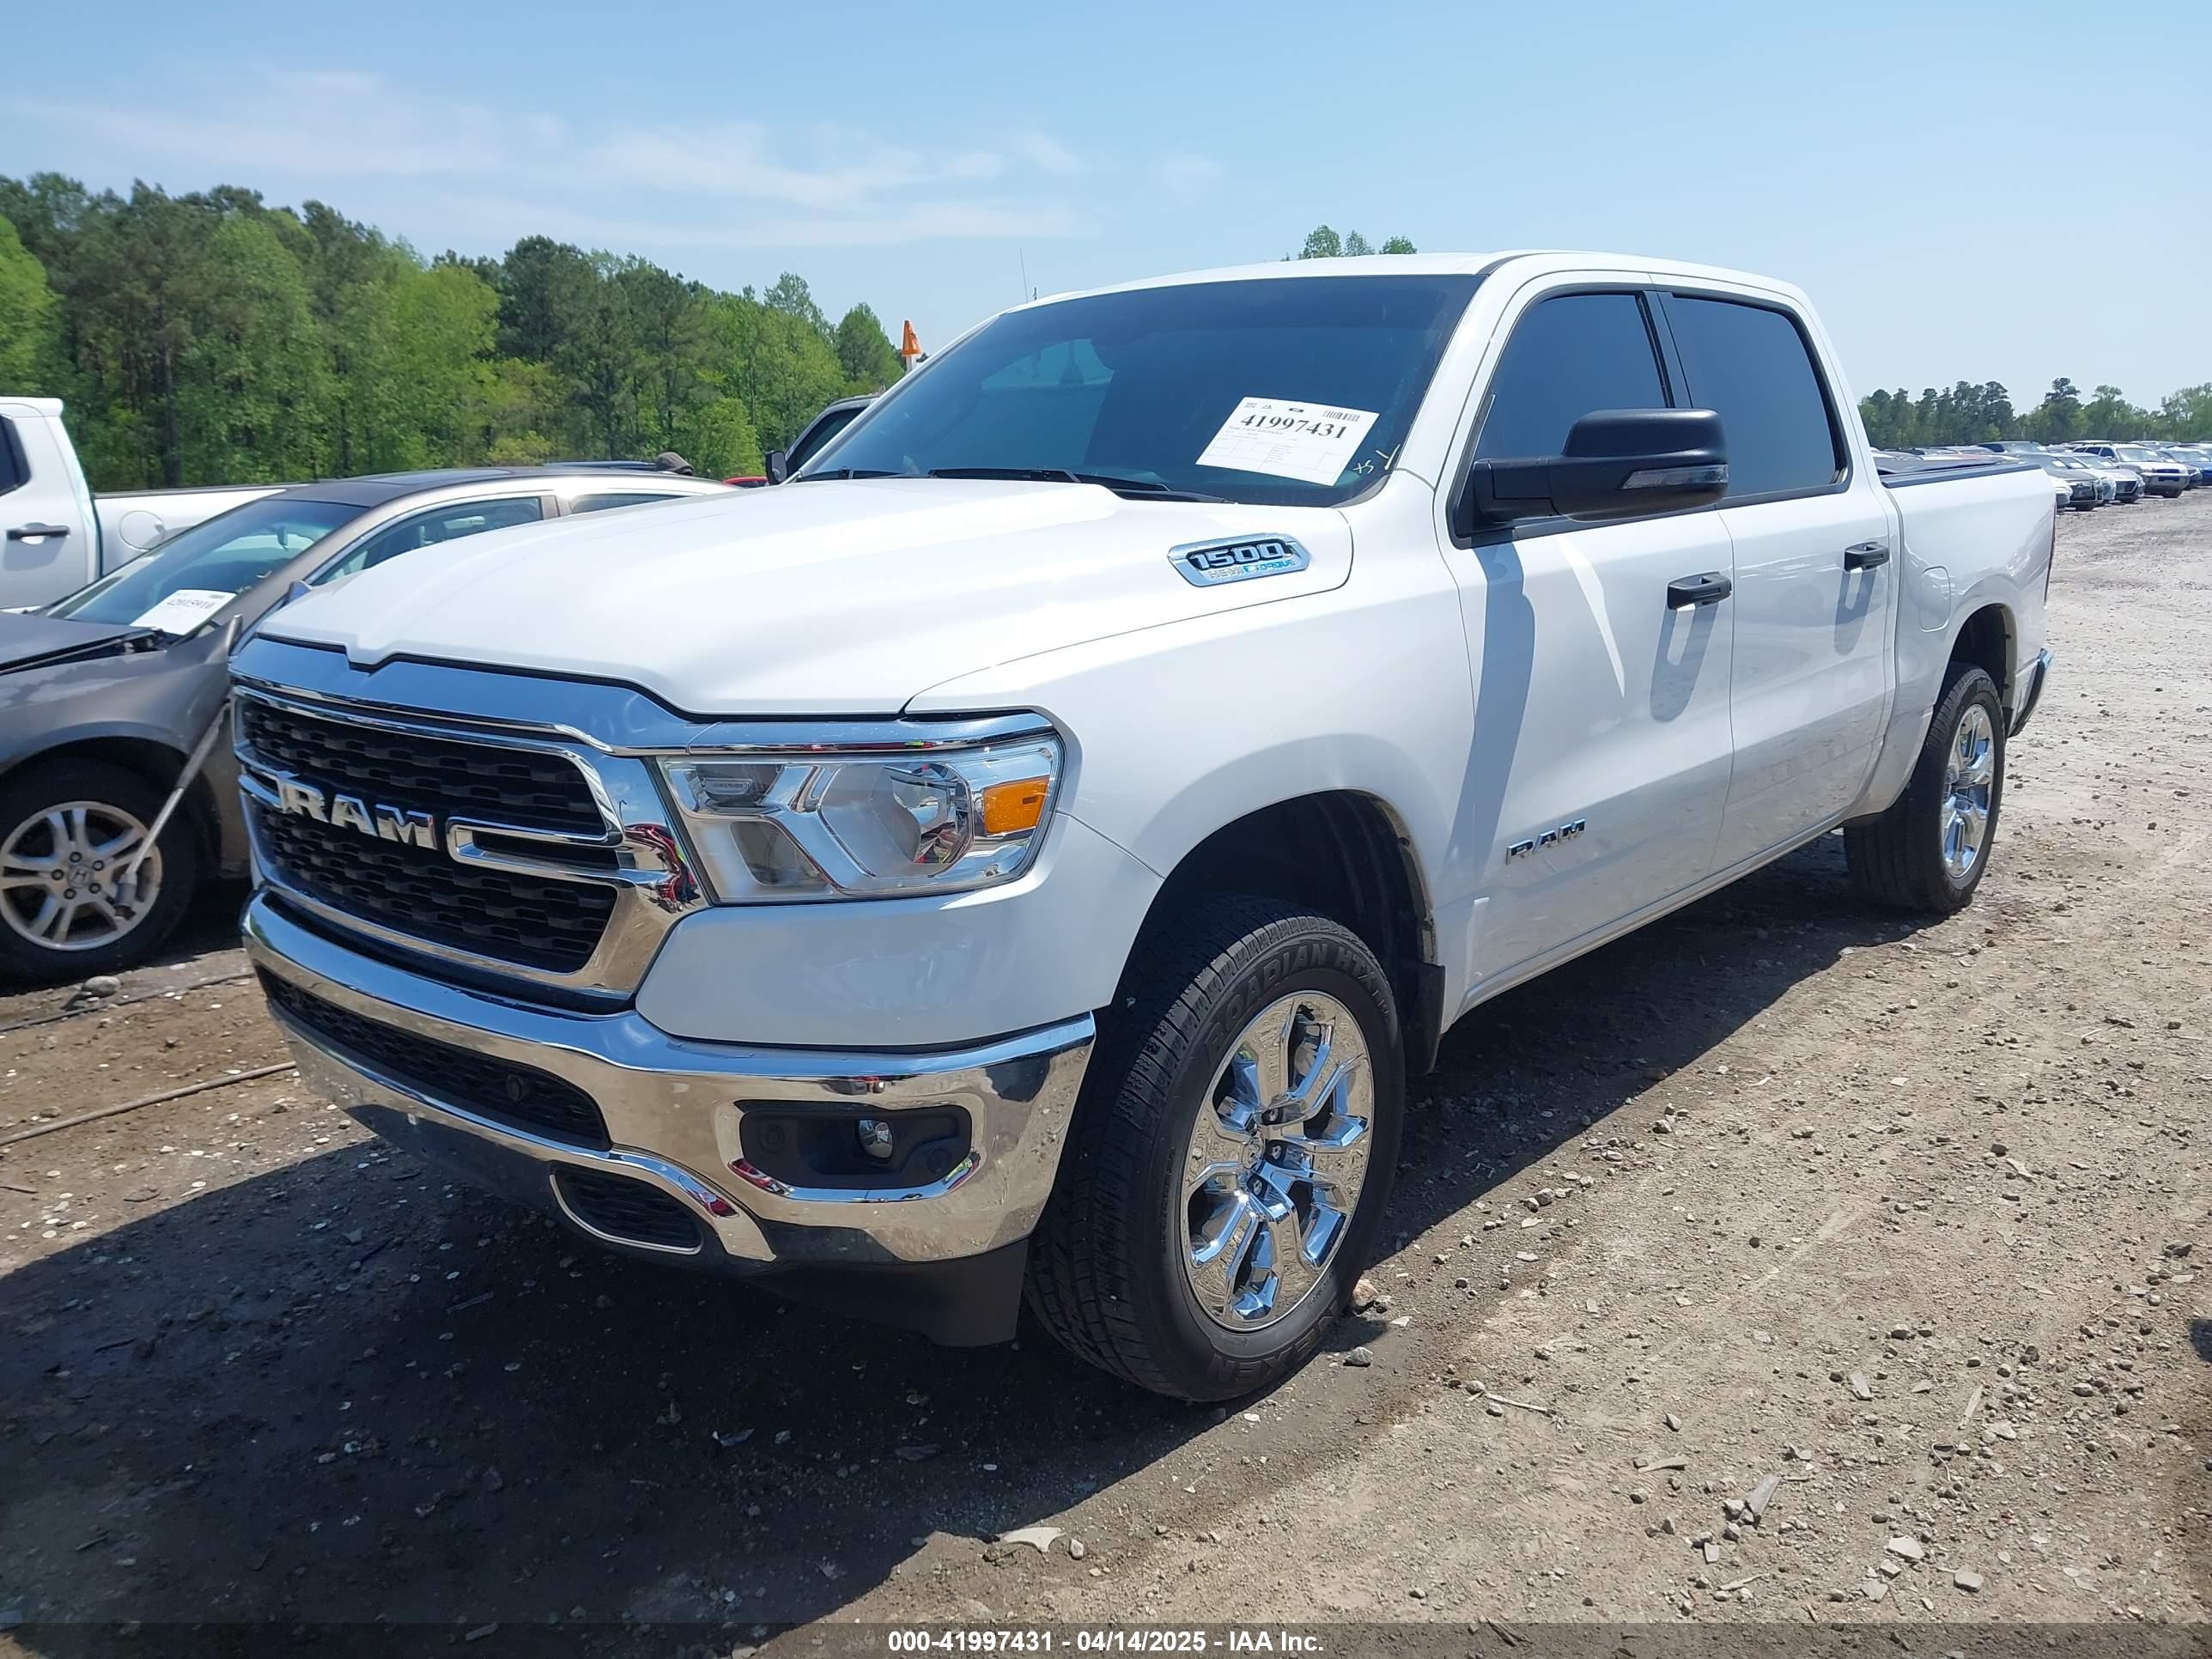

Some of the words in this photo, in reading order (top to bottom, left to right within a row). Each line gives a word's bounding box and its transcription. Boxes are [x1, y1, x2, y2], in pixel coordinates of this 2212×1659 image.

[1241, 414, 1347, 439] 41997431
[1191, 543, 1285, 568] 1500
[282, 776, 438, 851] RAM
[1505, 818, 1586, 865] RAM
